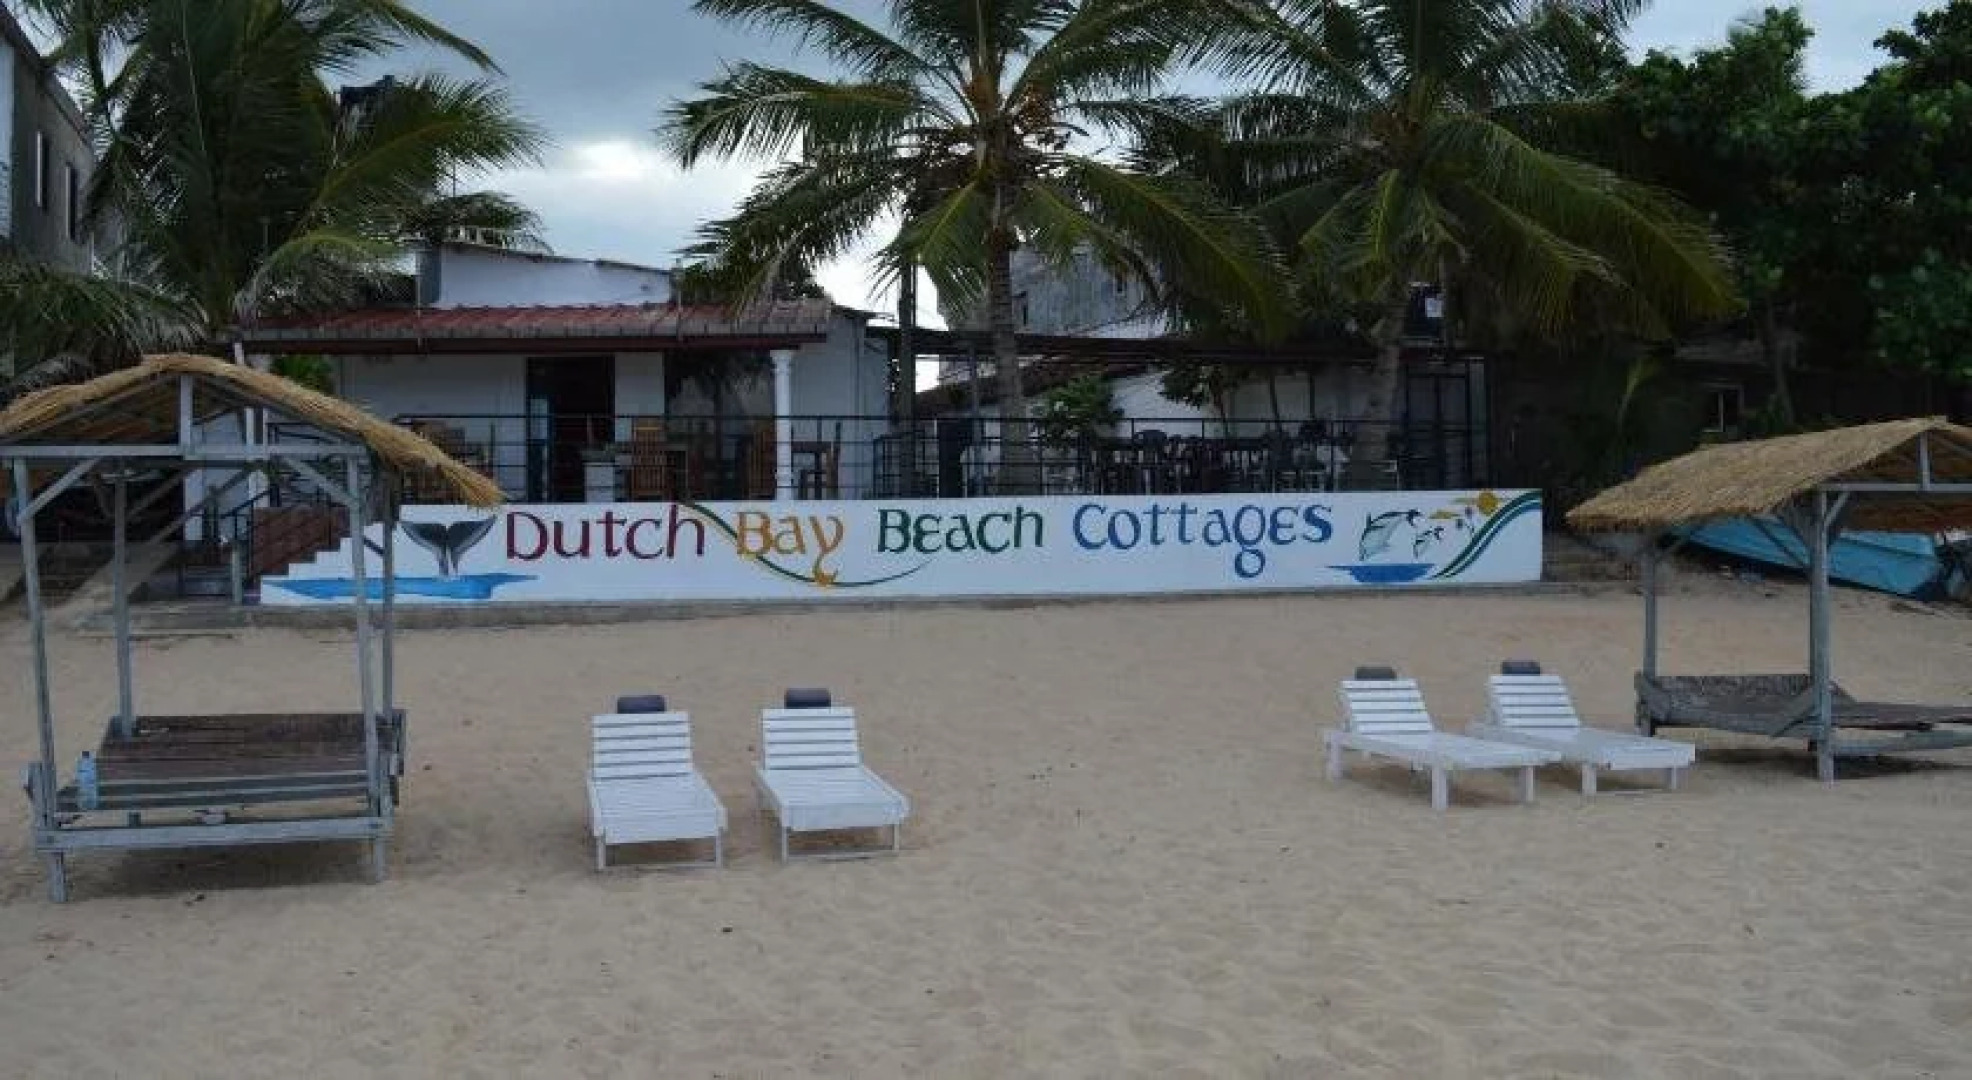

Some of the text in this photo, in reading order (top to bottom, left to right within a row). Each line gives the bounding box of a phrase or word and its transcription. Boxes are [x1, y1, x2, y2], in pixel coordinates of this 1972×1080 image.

[505, 503, 1333, 587] Dutch Bay Beach Cottages
